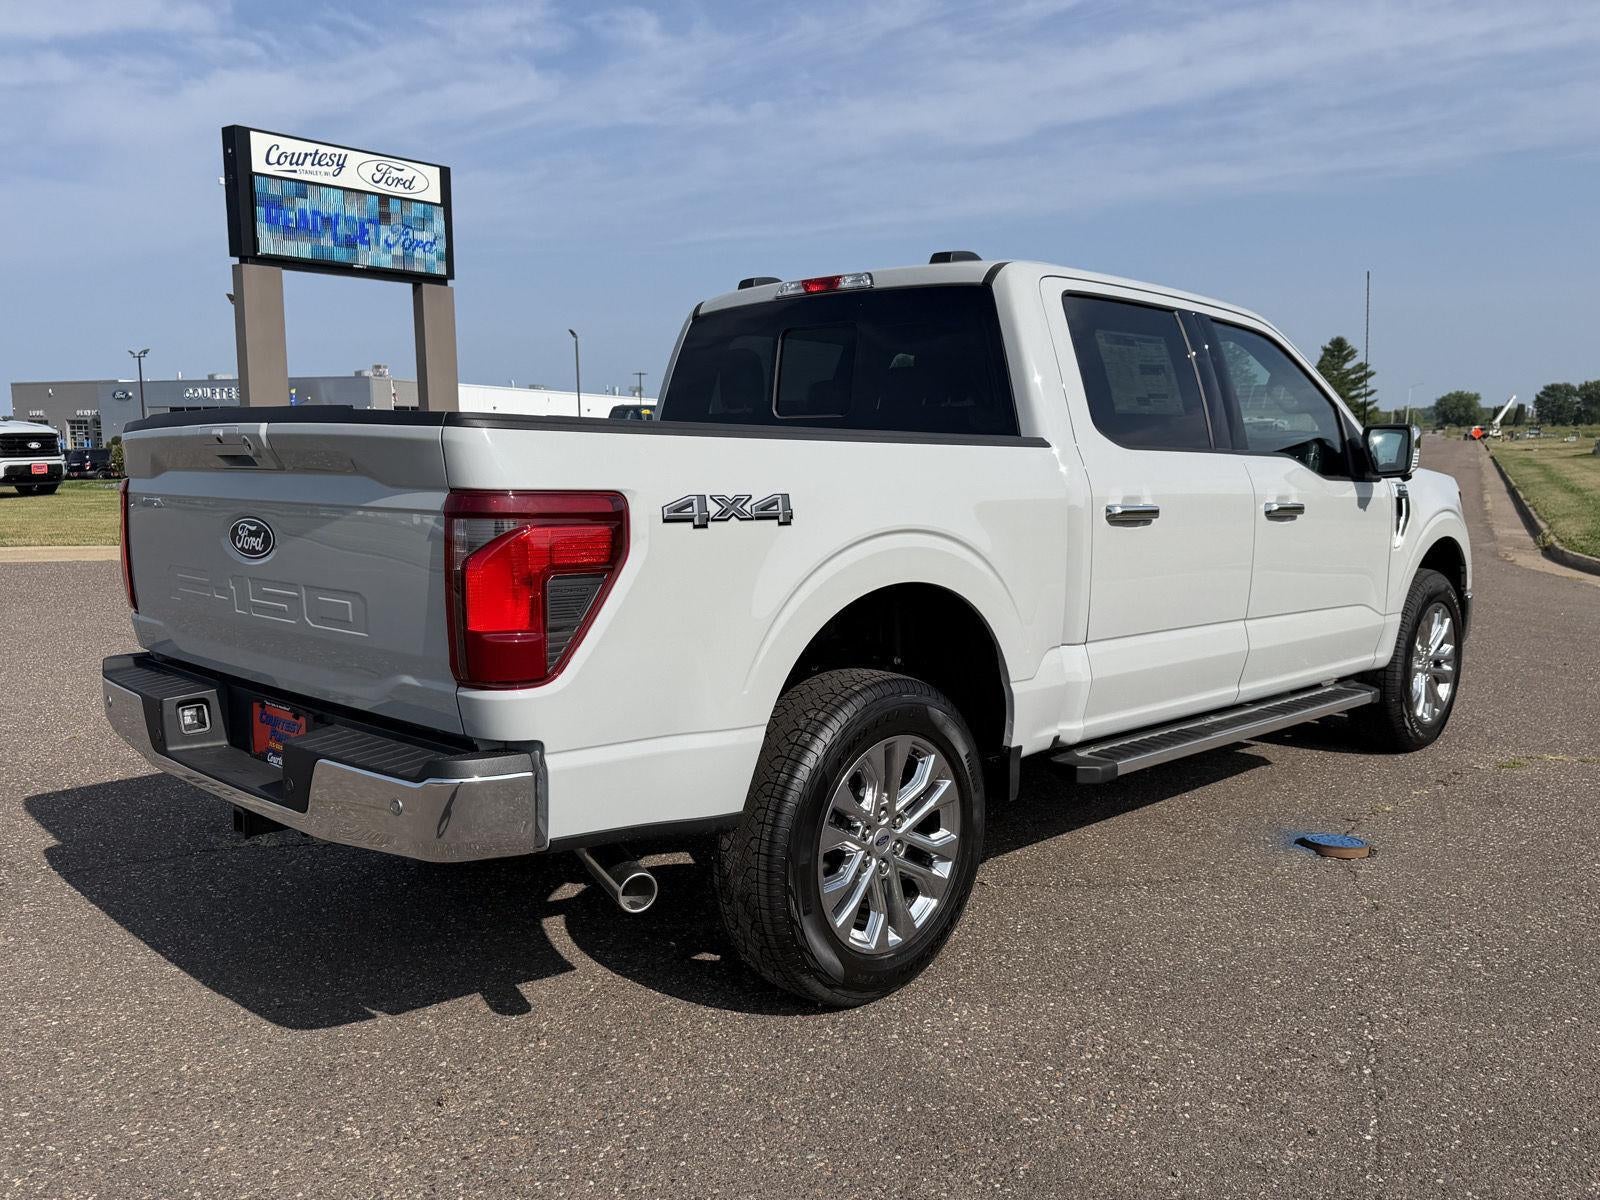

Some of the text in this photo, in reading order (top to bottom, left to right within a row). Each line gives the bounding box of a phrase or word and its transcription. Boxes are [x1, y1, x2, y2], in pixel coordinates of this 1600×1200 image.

[265, 144, 348, 177] Courtesy
[372, 162, 415, 191] Ford
[236, 522, 264, 552] Ford
